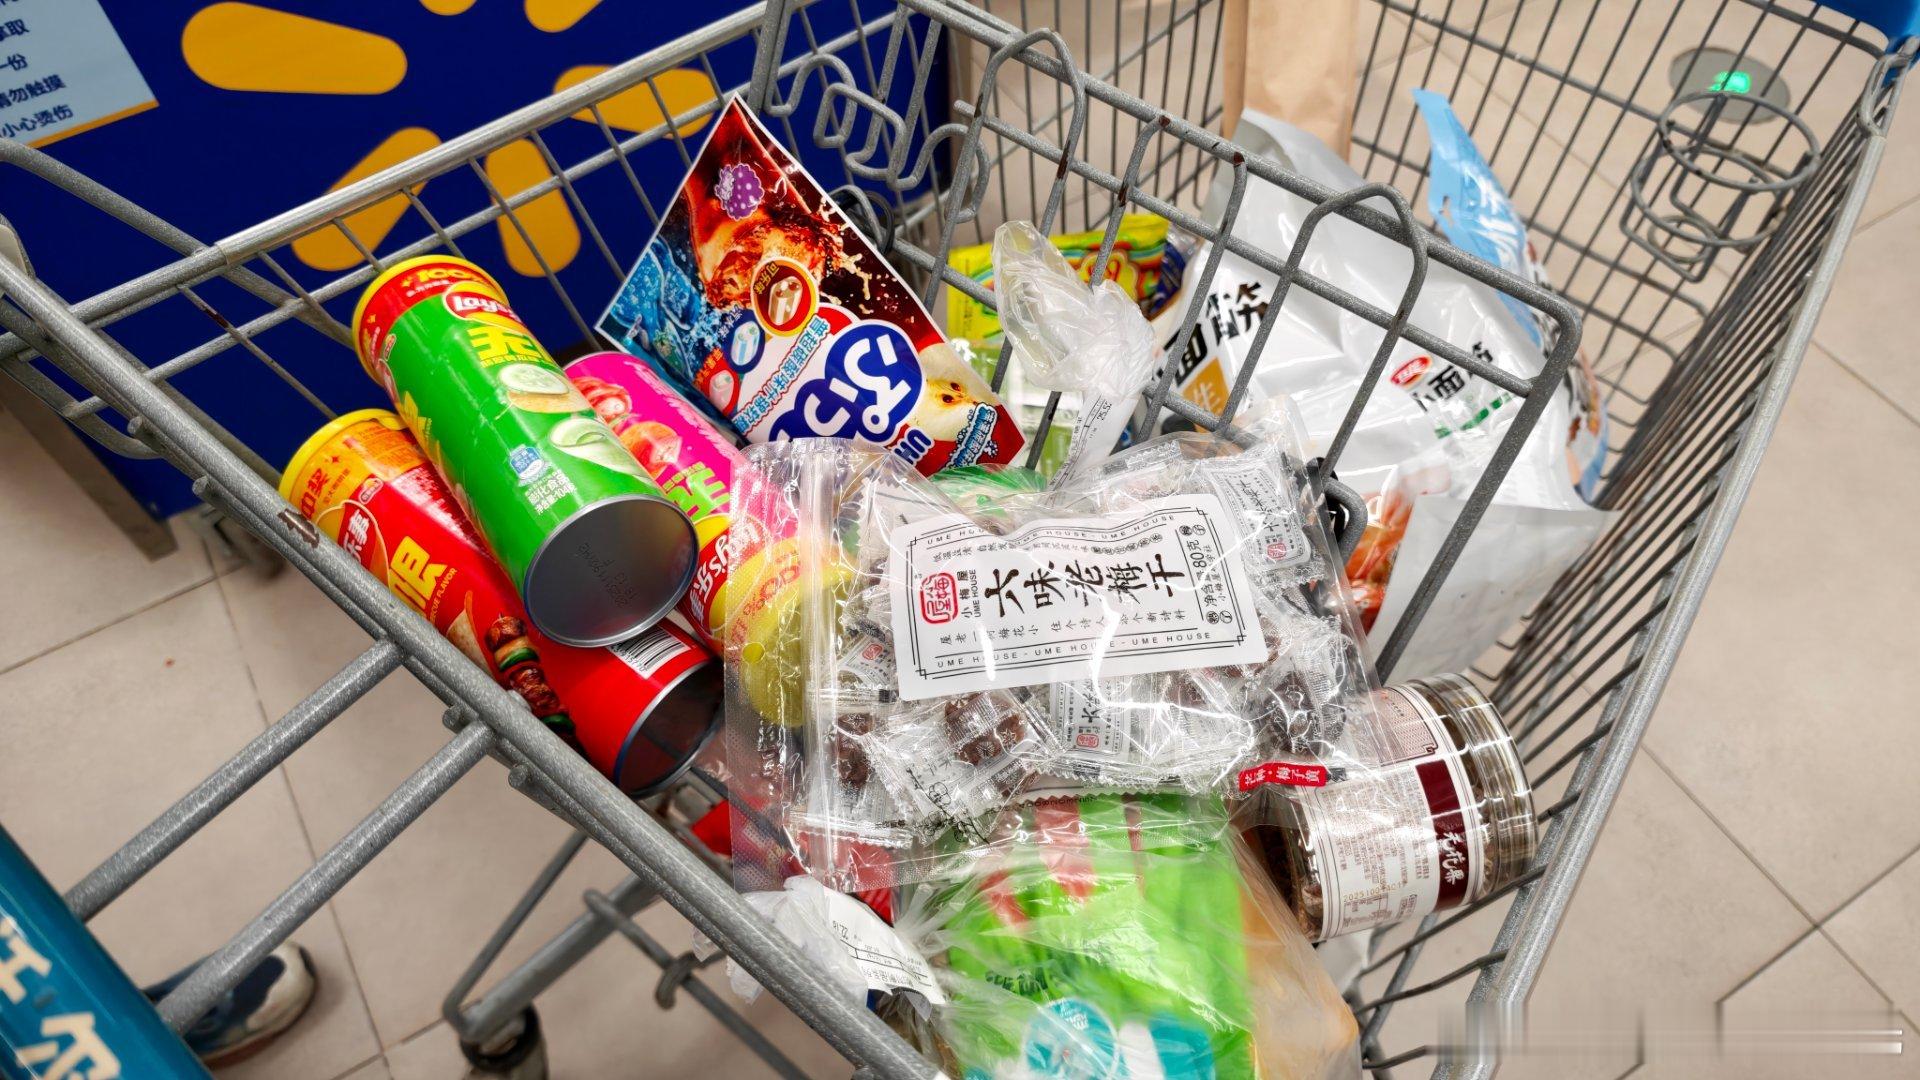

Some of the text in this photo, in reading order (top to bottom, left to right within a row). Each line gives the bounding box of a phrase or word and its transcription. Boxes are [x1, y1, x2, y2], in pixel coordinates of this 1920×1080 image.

[1, 104, 74, 138] 小心烫伤
[753, 261, 779, 295] 可乐味
[927, 532, 954, 546] UME
[1101, 526, 1128, 540] UME
[1132, 513, 1177, 533] HOUSE
[436, 567, 459, 600] FLAVOR
[957, 568, 973, 619] 小梅屋
[968, 568, 983, 619] UME HOUSE
[983, 553, 1186, 619] 六味老梅干
[937, 654, 967, 669] UME
[1034, 645, 1063, 659] UME
[1131, 635, 1159, 649] UME
[1165, 630, 1212, 644] HOUSE
[1441, 830, 1466, 886] 无花果
